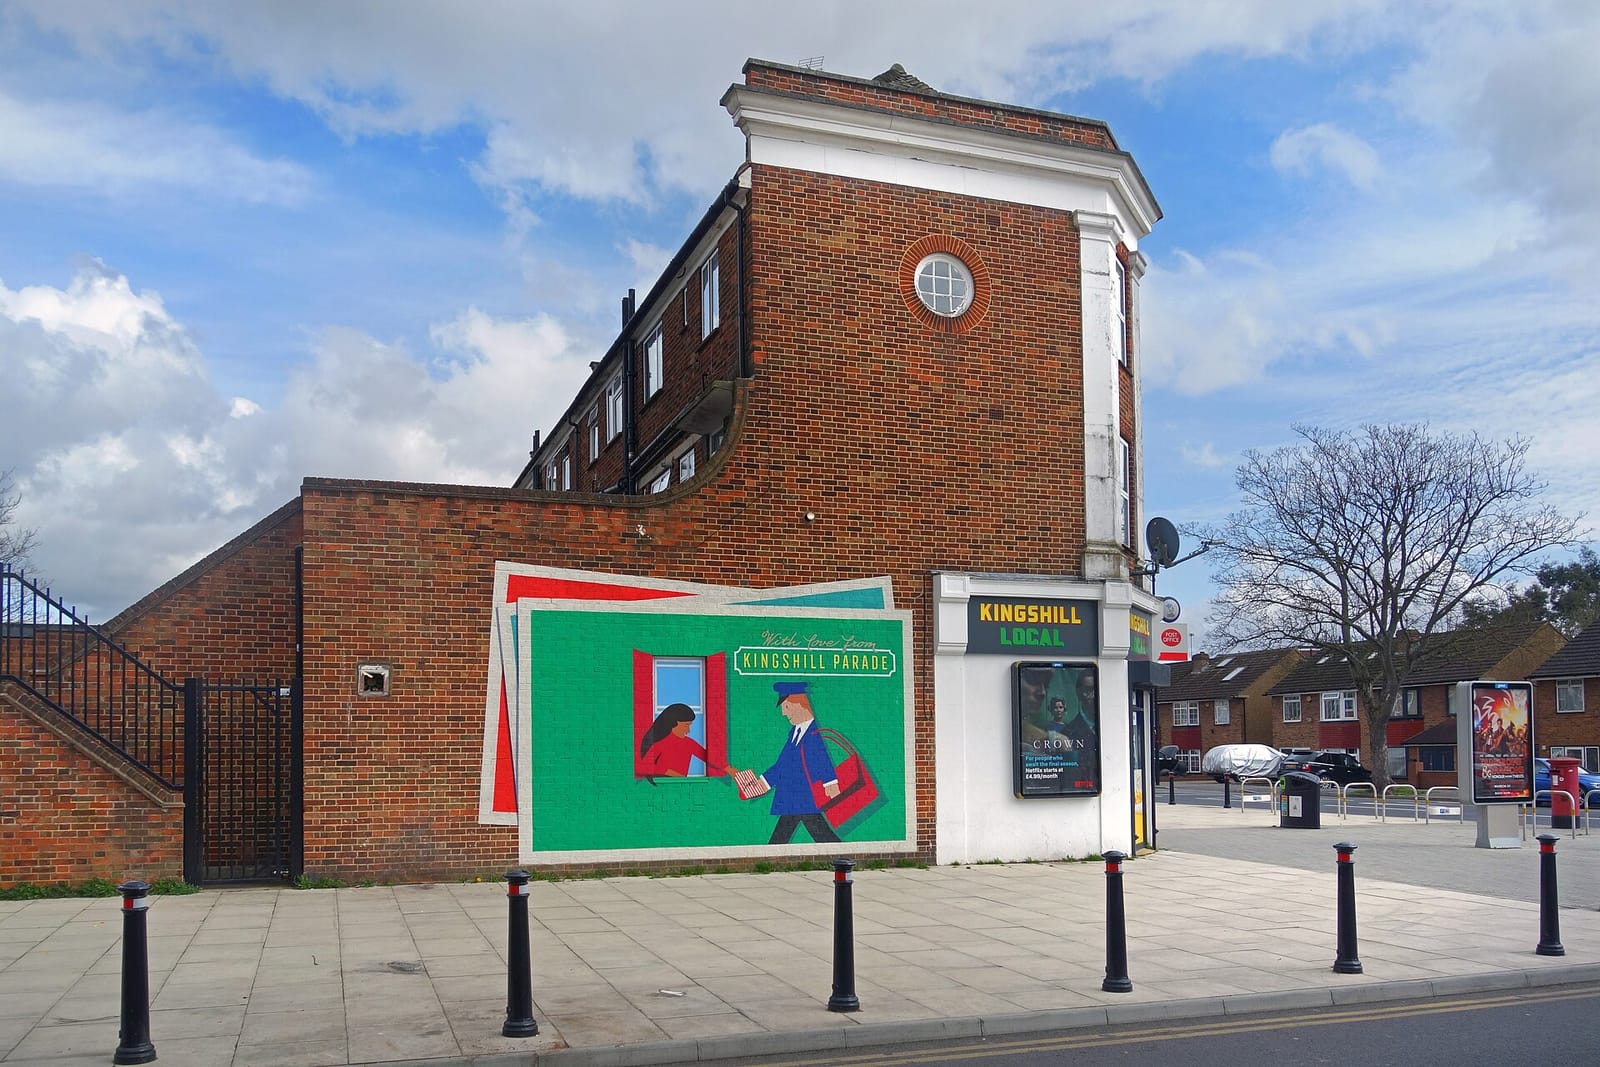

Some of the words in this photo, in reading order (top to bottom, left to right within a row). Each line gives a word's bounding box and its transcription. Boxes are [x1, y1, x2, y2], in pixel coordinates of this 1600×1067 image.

[980, 603, 1082, 624] KINGSHILL
[761, 630, 800, 647] With
[1000, 627, 1065, 647] LOCAL
[743, 653, 825, 669] KINGSHILL
[833, 654, 888, 671] PARADE
[1033, 739, 1085, 749] CROWN
